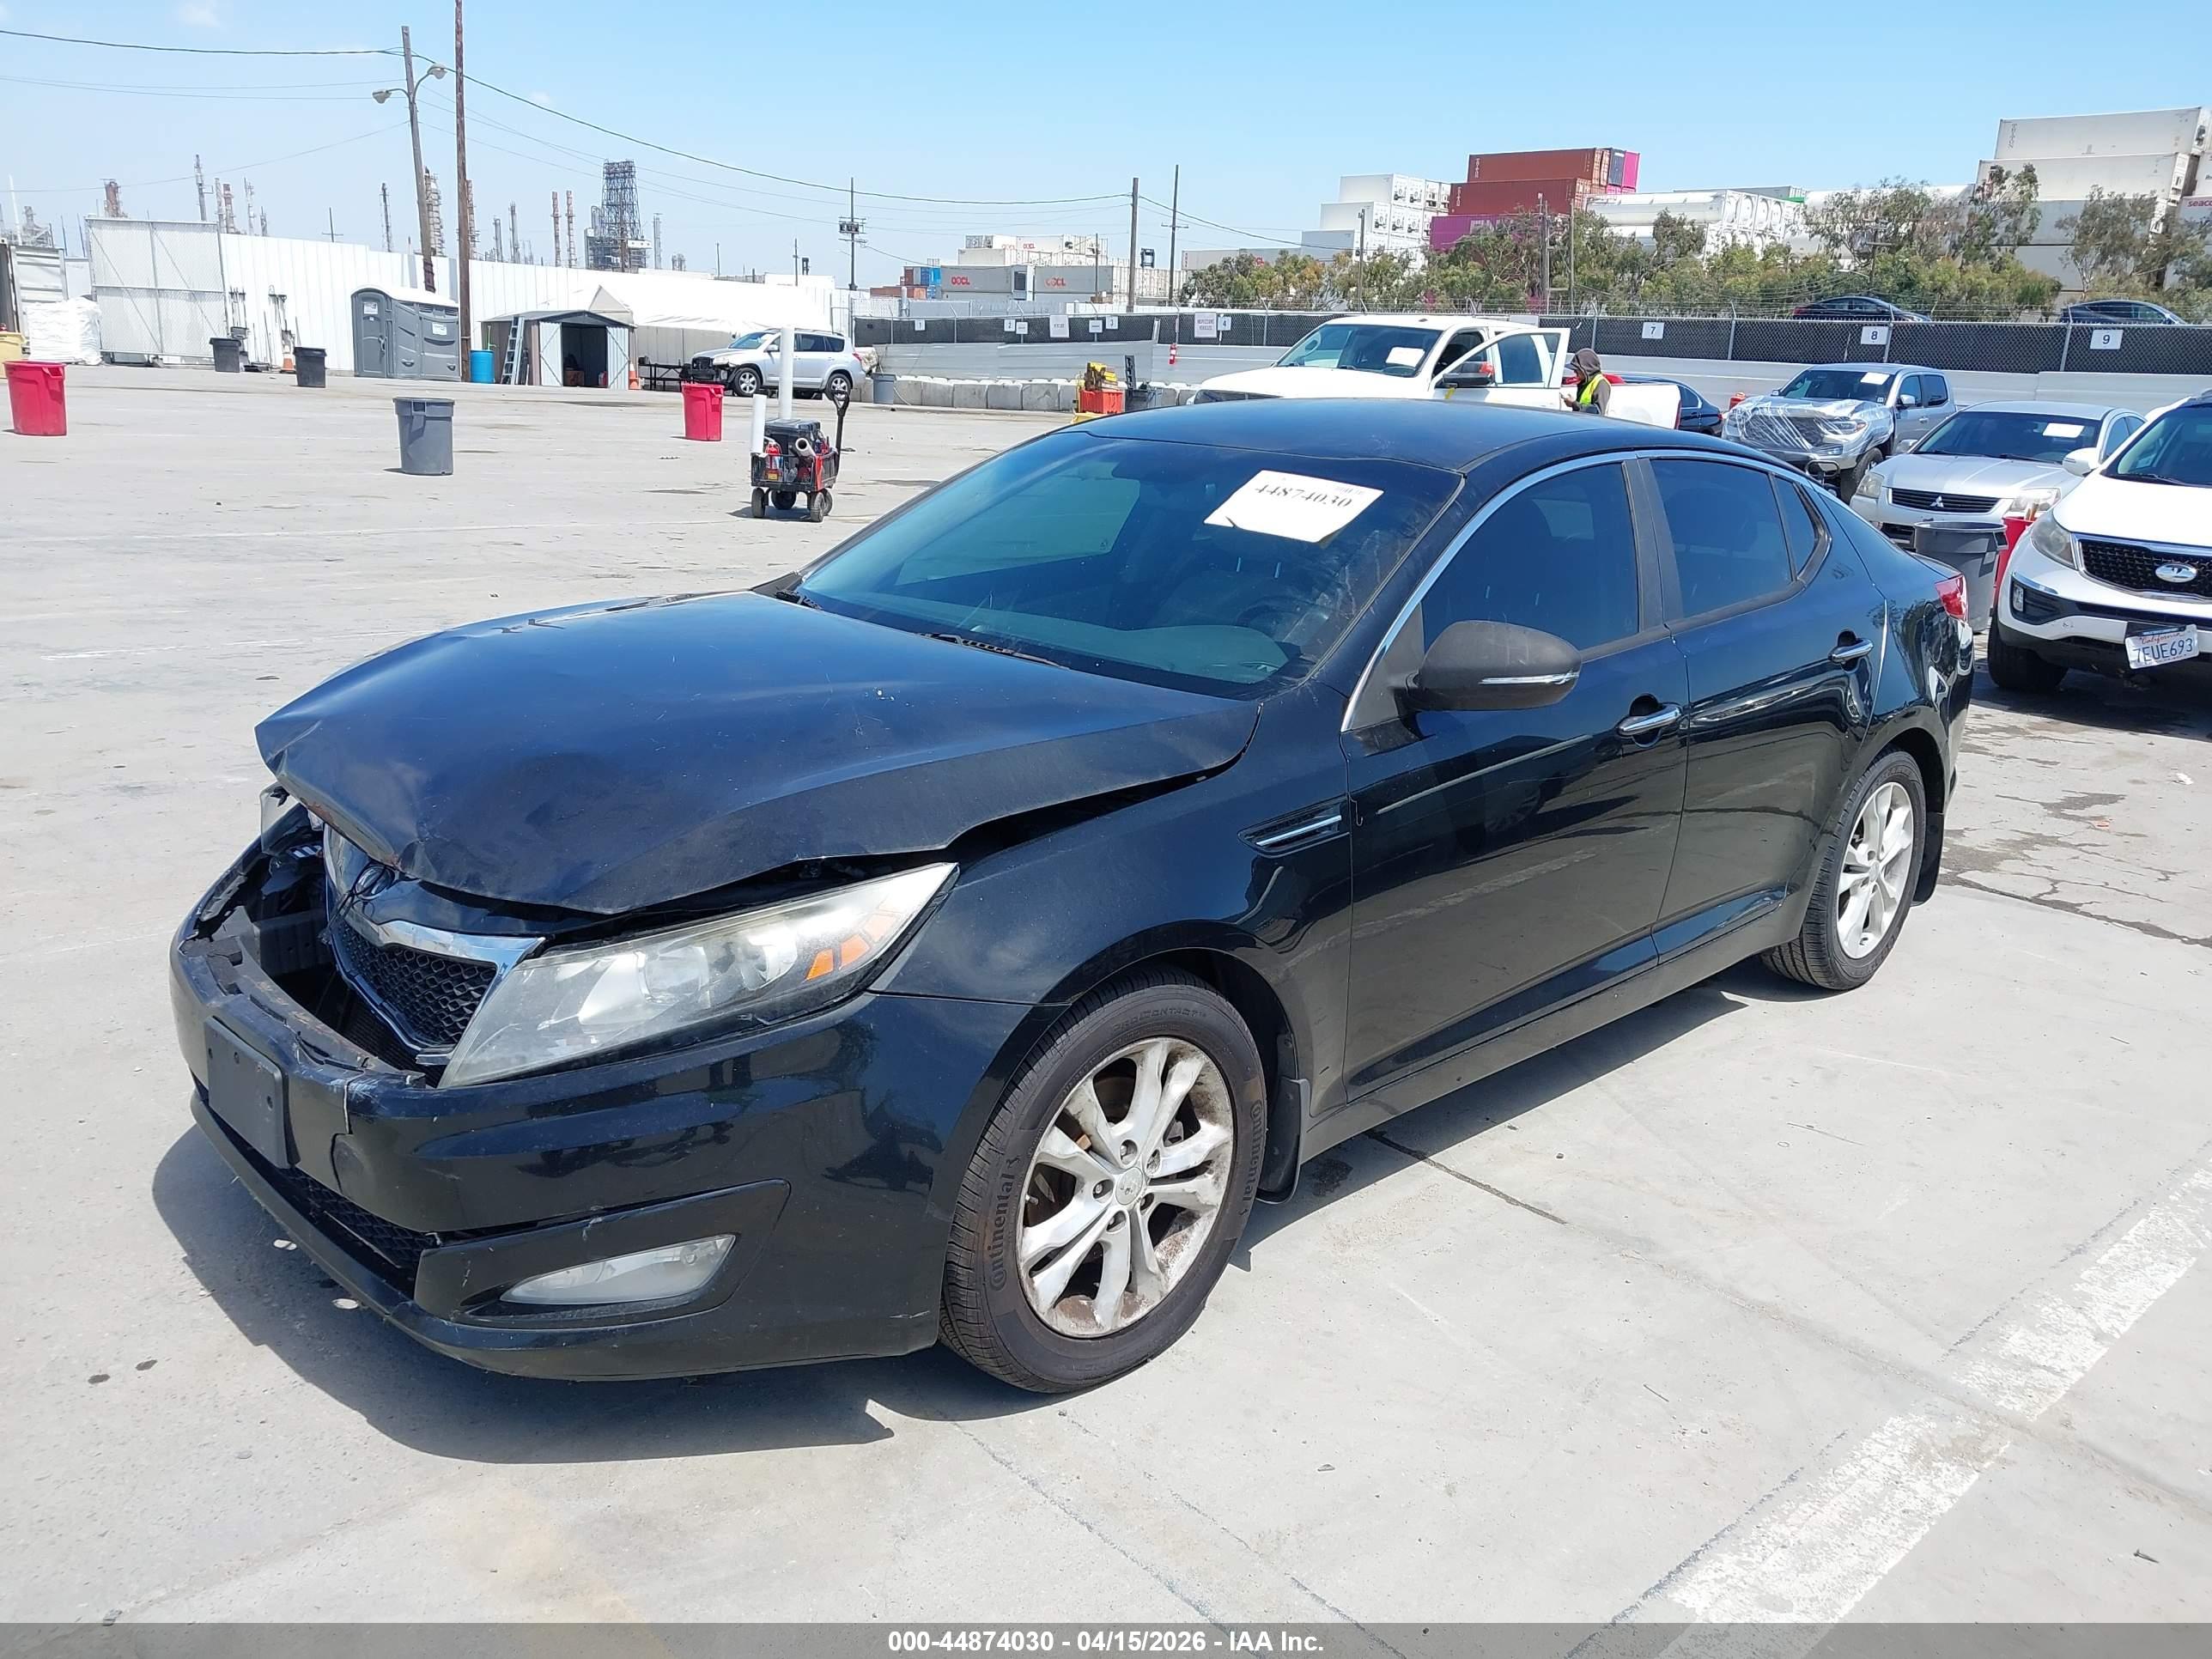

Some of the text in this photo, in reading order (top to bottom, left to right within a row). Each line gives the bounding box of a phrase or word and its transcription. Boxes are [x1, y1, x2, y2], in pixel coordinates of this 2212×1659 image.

[951, 276, 970, 286] OOCL
[1650, 325, 1656, 335] 7
[1870, 331, 1878, 340] 8
[2102, 334, 2111, 344] 9
[1255, 484, 1352, 507] 44874030
[2132, 638, 2193, 663] 7EUE693
[989, 1172, 1015, 1291] Continental
